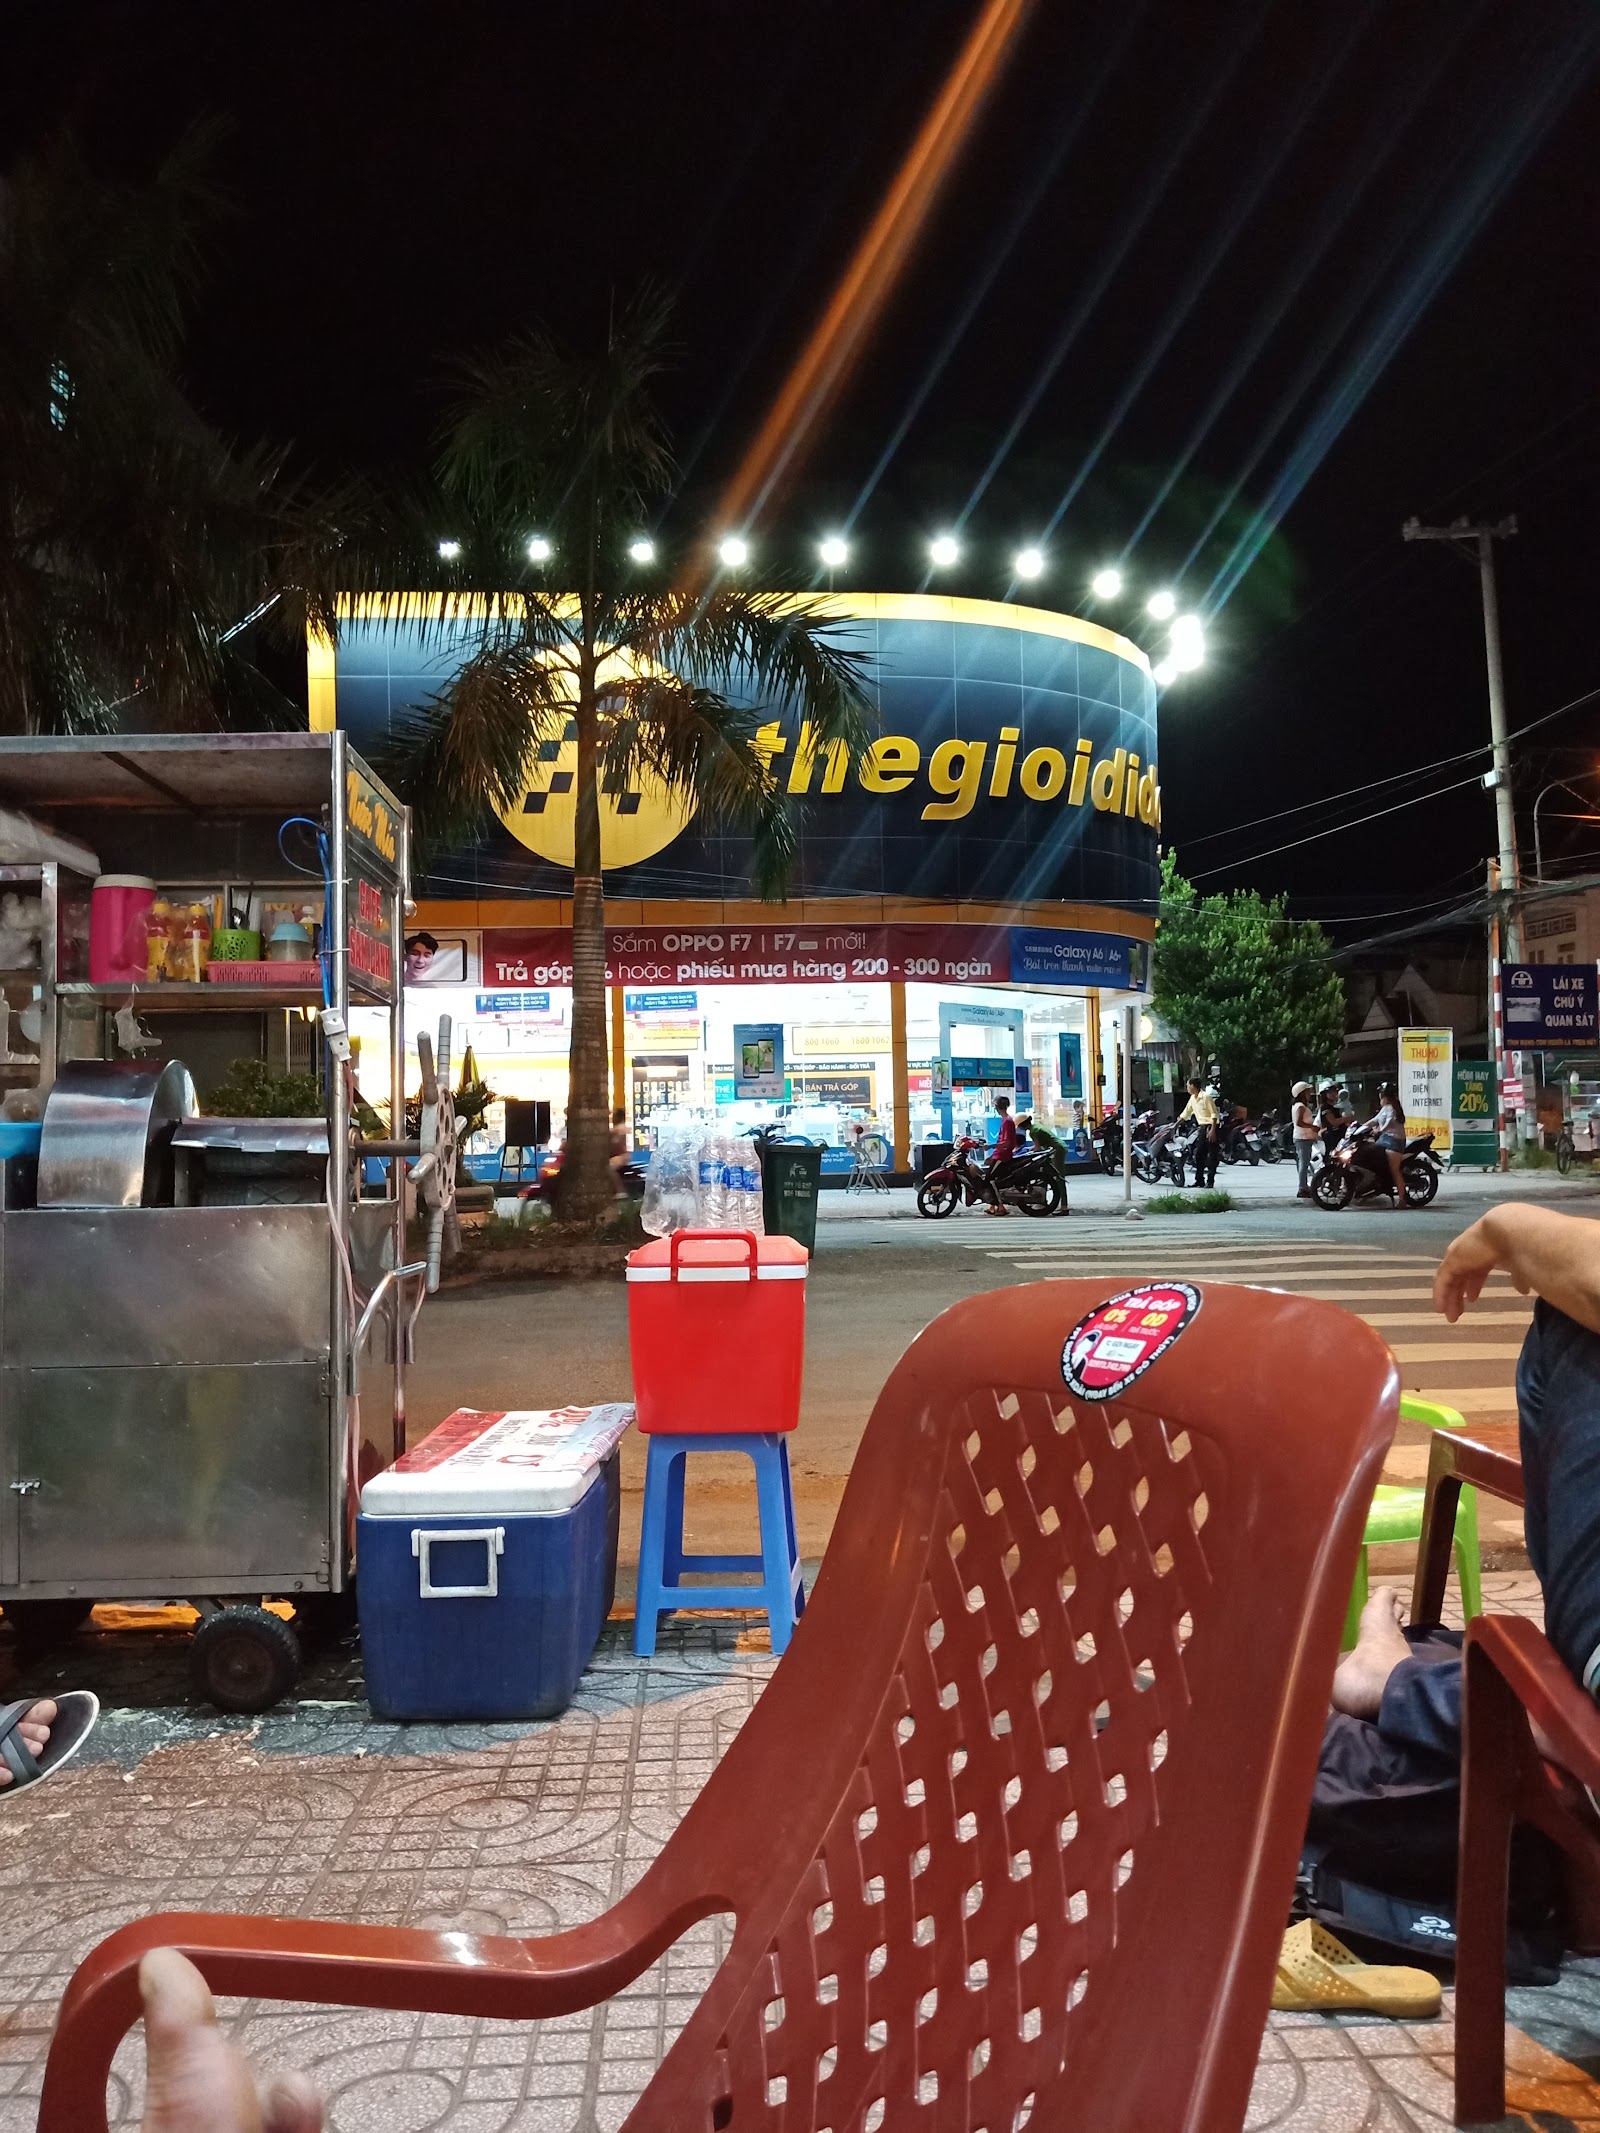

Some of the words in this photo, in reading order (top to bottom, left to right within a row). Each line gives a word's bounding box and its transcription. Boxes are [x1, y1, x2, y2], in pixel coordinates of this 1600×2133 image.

[747, 720, 1162, 834] thegioidid
[612, 934, 656, 953] Sắm
[662, 934, 724, 952] OPPO
[730, 934, 752, 952] F7
[774, 933, 798, 951] F7
[826, 932, 867, 951] mới!
[1024, 946, 1053, 954] SAMSUNG
[1054, 944, 1092, 962] Galaxy
[1093, 947, 1104, 960] A6
[495, 961, 529, 982] Trả
[618, 962, 672, 984] hoặc
[676, 958, 736, 982] phiếu
[740, 963, 787, 979] mua
[793, 958, 846, 982] hàng
[852, 958, 889, 976] 200
[904, 958, 940, 976] 300
[945, 957, 992, 981] ngàn
[1552, 975, 1568, 990] LÁI
[1570, 978, 1584, 990] XE
[1553, 993, 1574, 1008] CHÚ
[1576, 992, 1583, 1008] Ý
[972, 1007, 989, 1017] Galaxy
[1545, 1014, 1572, 1026] QUAN
[1575, 1011, 1594, 1026] SÁT
[1411, 1048, 1427, 1059] THU
[1413, 1068, 1426, 1079] TRẢ
[1427, 1069, 1438, 1079] GÓP
[1457, 1069, 1474, 1080] HÔM
[1475, 1071, 1489, 1080] NAY
[806, 1083, 822, 1091] BÁN
[824, 1082, 839, 1091] TRẢ
[841, 1082, 859, 1091] GÓP
[1412, 1083, 1429, 1095] ĐIỆN
[1412, 1098, 1443, 1107] INTERNET
[1459, 1093, 1488, 1113] 20%
[1124, 1296, 1153, 1309] TRẢ
[1148, 1298, 1181, 1312] GÓP
[1103, 1309, 1130, 1324] 0%
